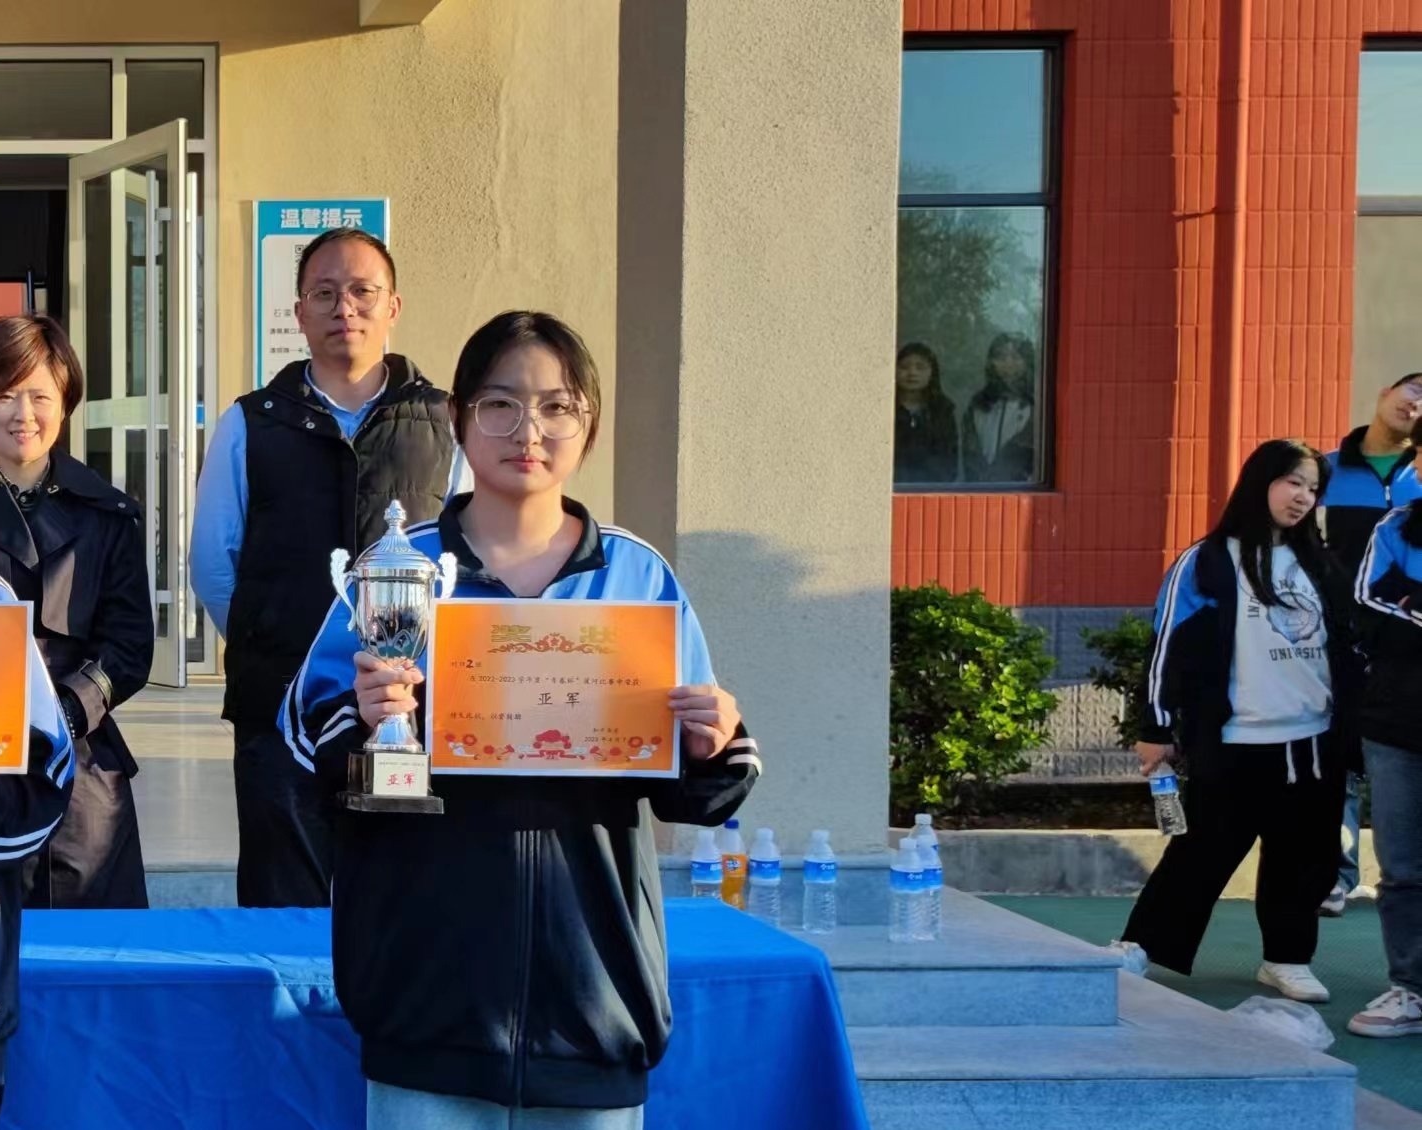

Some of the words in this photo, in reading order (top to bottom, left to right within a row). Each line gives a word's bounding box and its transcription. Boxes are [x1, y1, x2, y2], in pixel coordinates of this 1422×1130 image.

[281, 208, 363, 229] 温馨提示
[537, 691, 581, 707] 亚军
